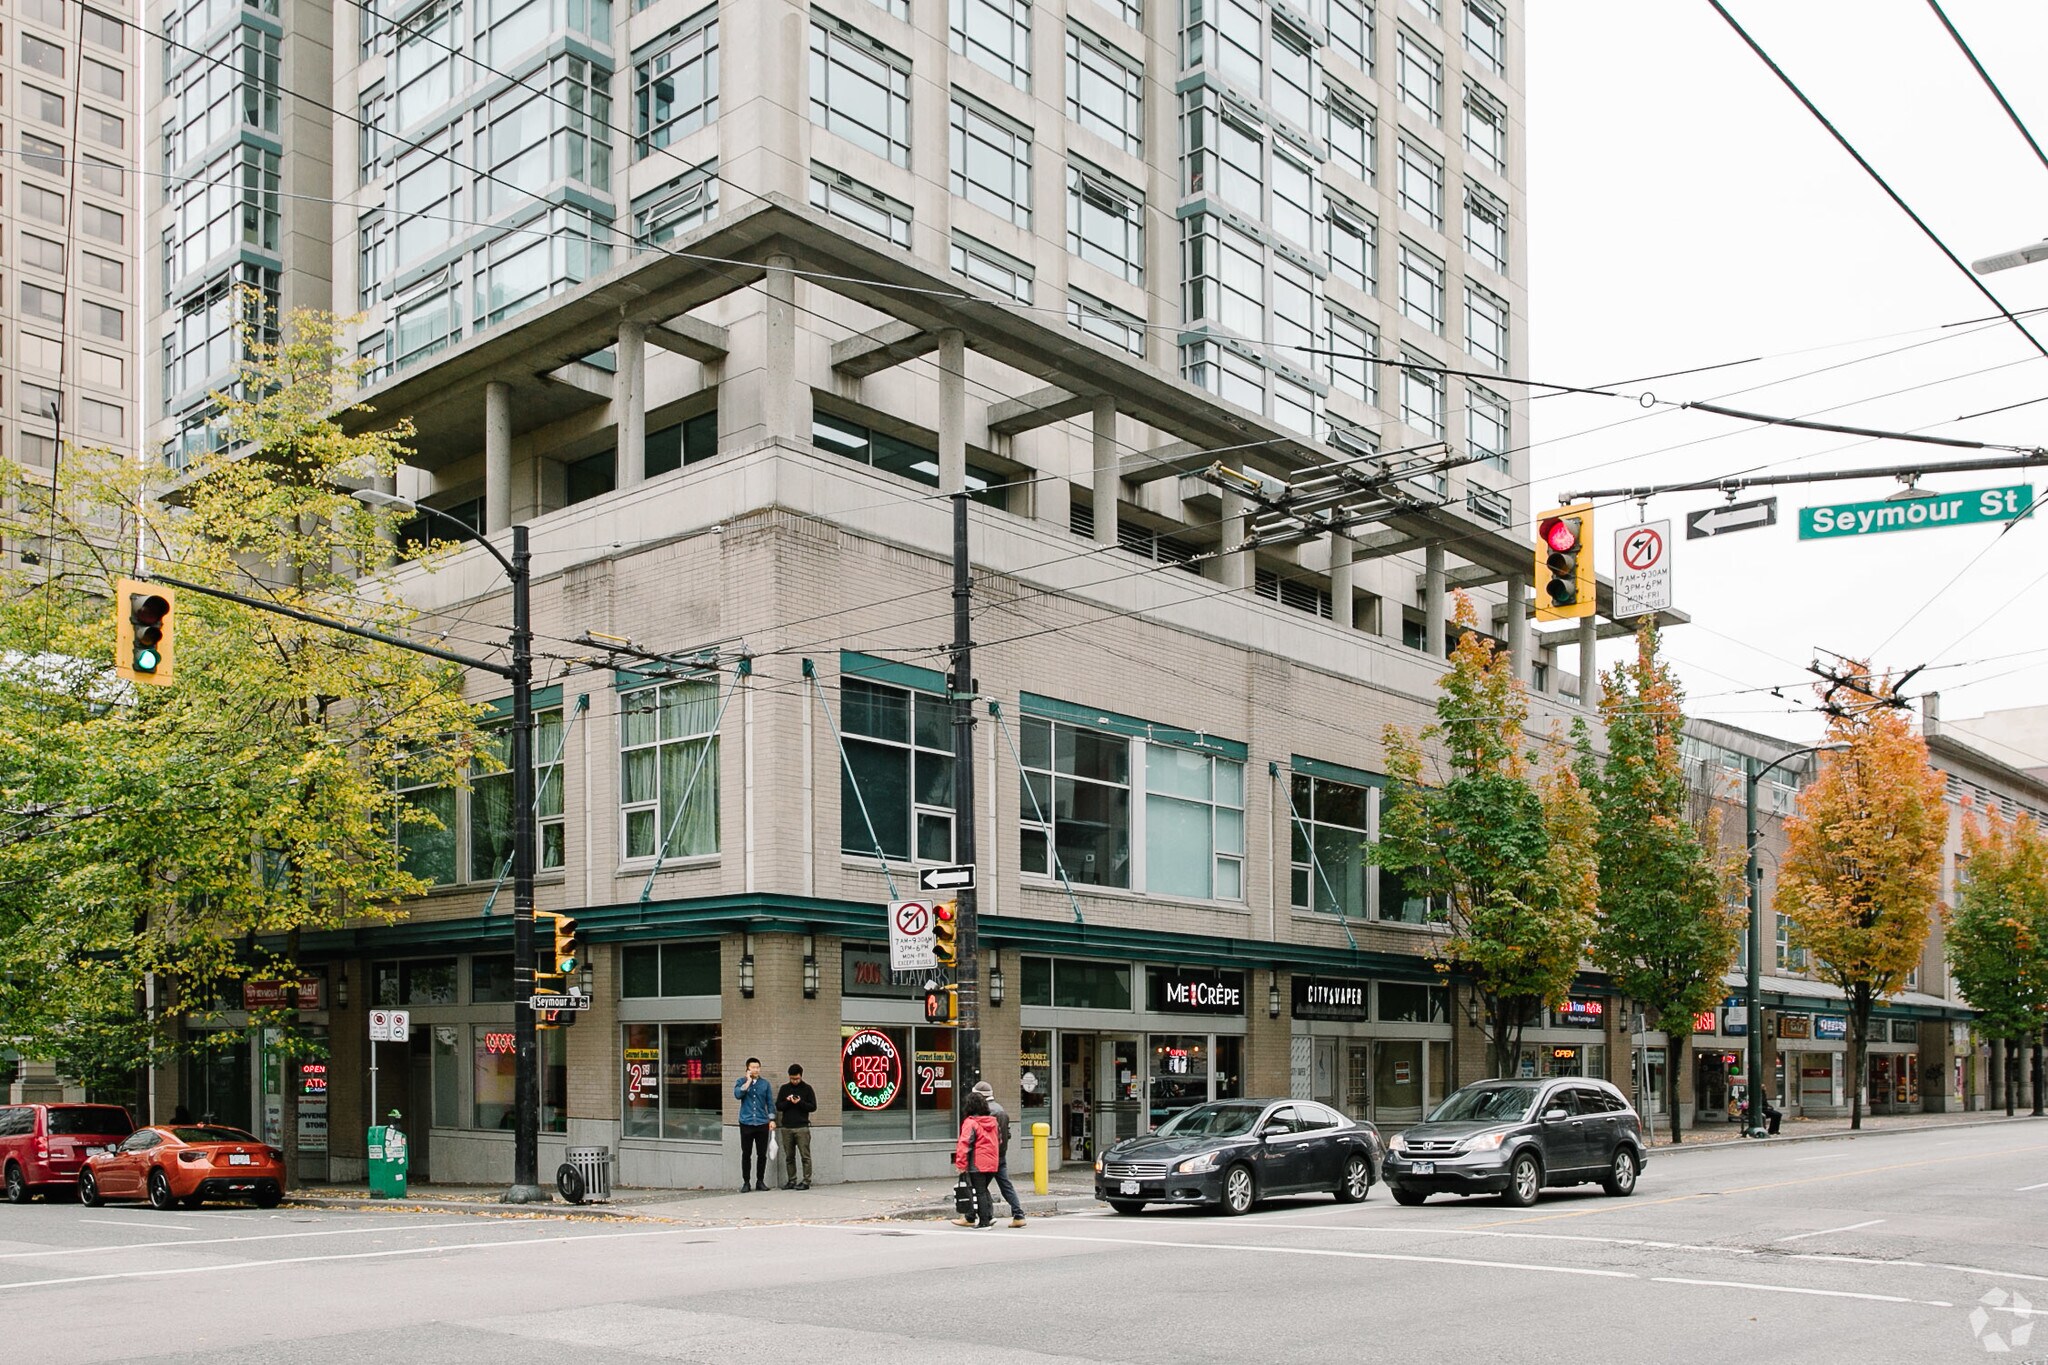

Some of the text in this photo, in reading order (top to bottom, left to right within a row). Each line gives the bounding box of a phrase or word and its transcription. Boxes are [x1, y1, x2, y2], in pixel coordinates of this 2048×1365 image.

[1812, 490, 2018, 534] Seymour St
[536, 997, 568, 1008] Seymour
[847, 1034, 895, 1059] FANTASTICO
[1554, 1049, 1575, 1059] OPEN
[302, 1065, 326, 1073] OPEN
[854, 1055, 890, 1073] PIZZA
[857, 1072, 888, 1089] 2001
[305, 1121, 327, 1129] STOR
